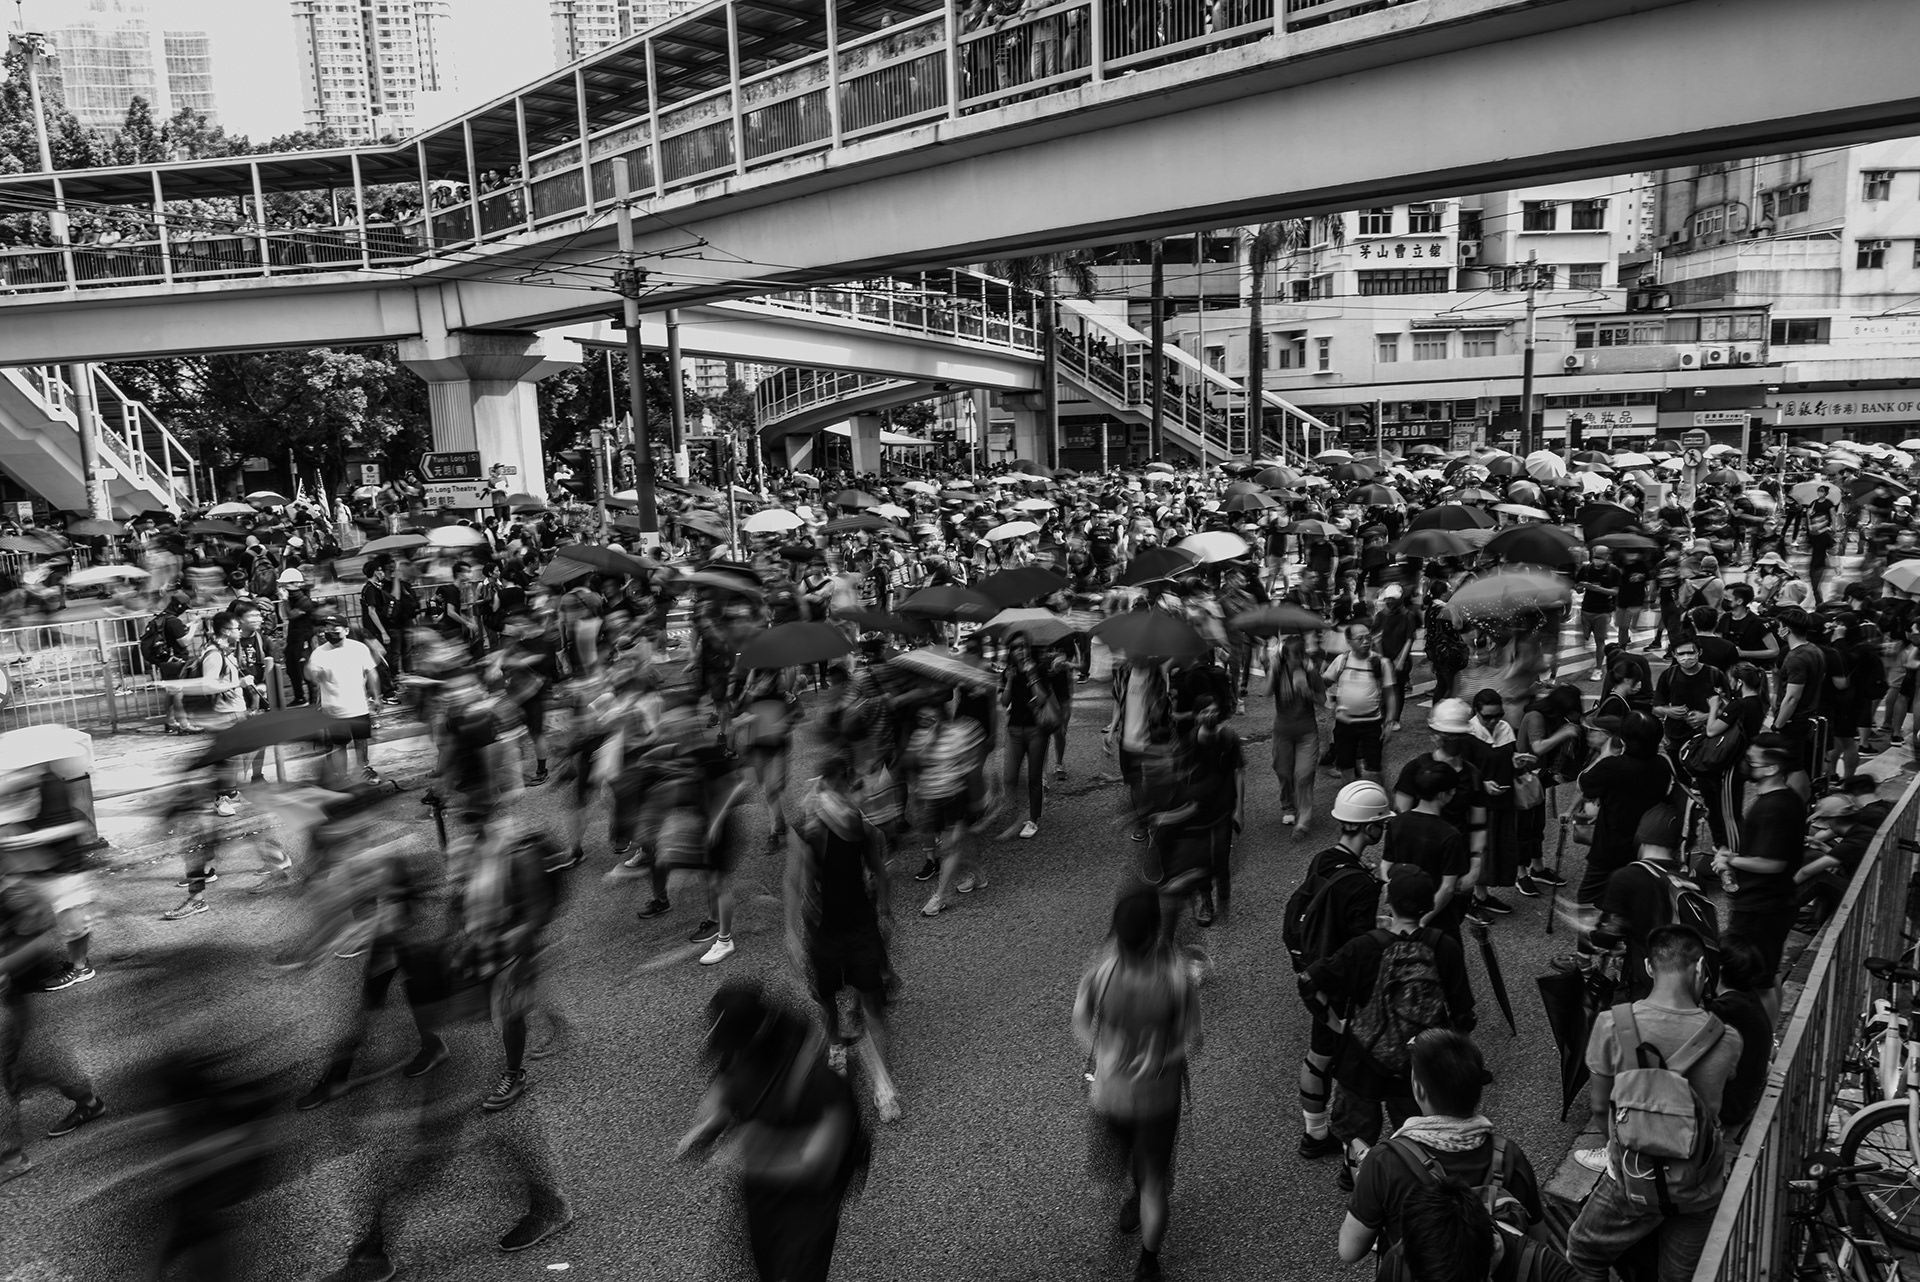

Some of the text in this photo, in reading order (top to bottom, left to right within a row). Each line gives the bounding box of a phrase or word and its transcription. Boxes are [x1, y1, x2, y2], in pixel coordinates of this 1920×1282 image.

[1861, 402, 1895, 414] BANK
[1897, 401, 1914, 412] OF
[432, 453, 479, 464] Yuen Long (S)
[434, 464, 468, 477] 元朗(南)
[435, 486, 451, 494] Long
